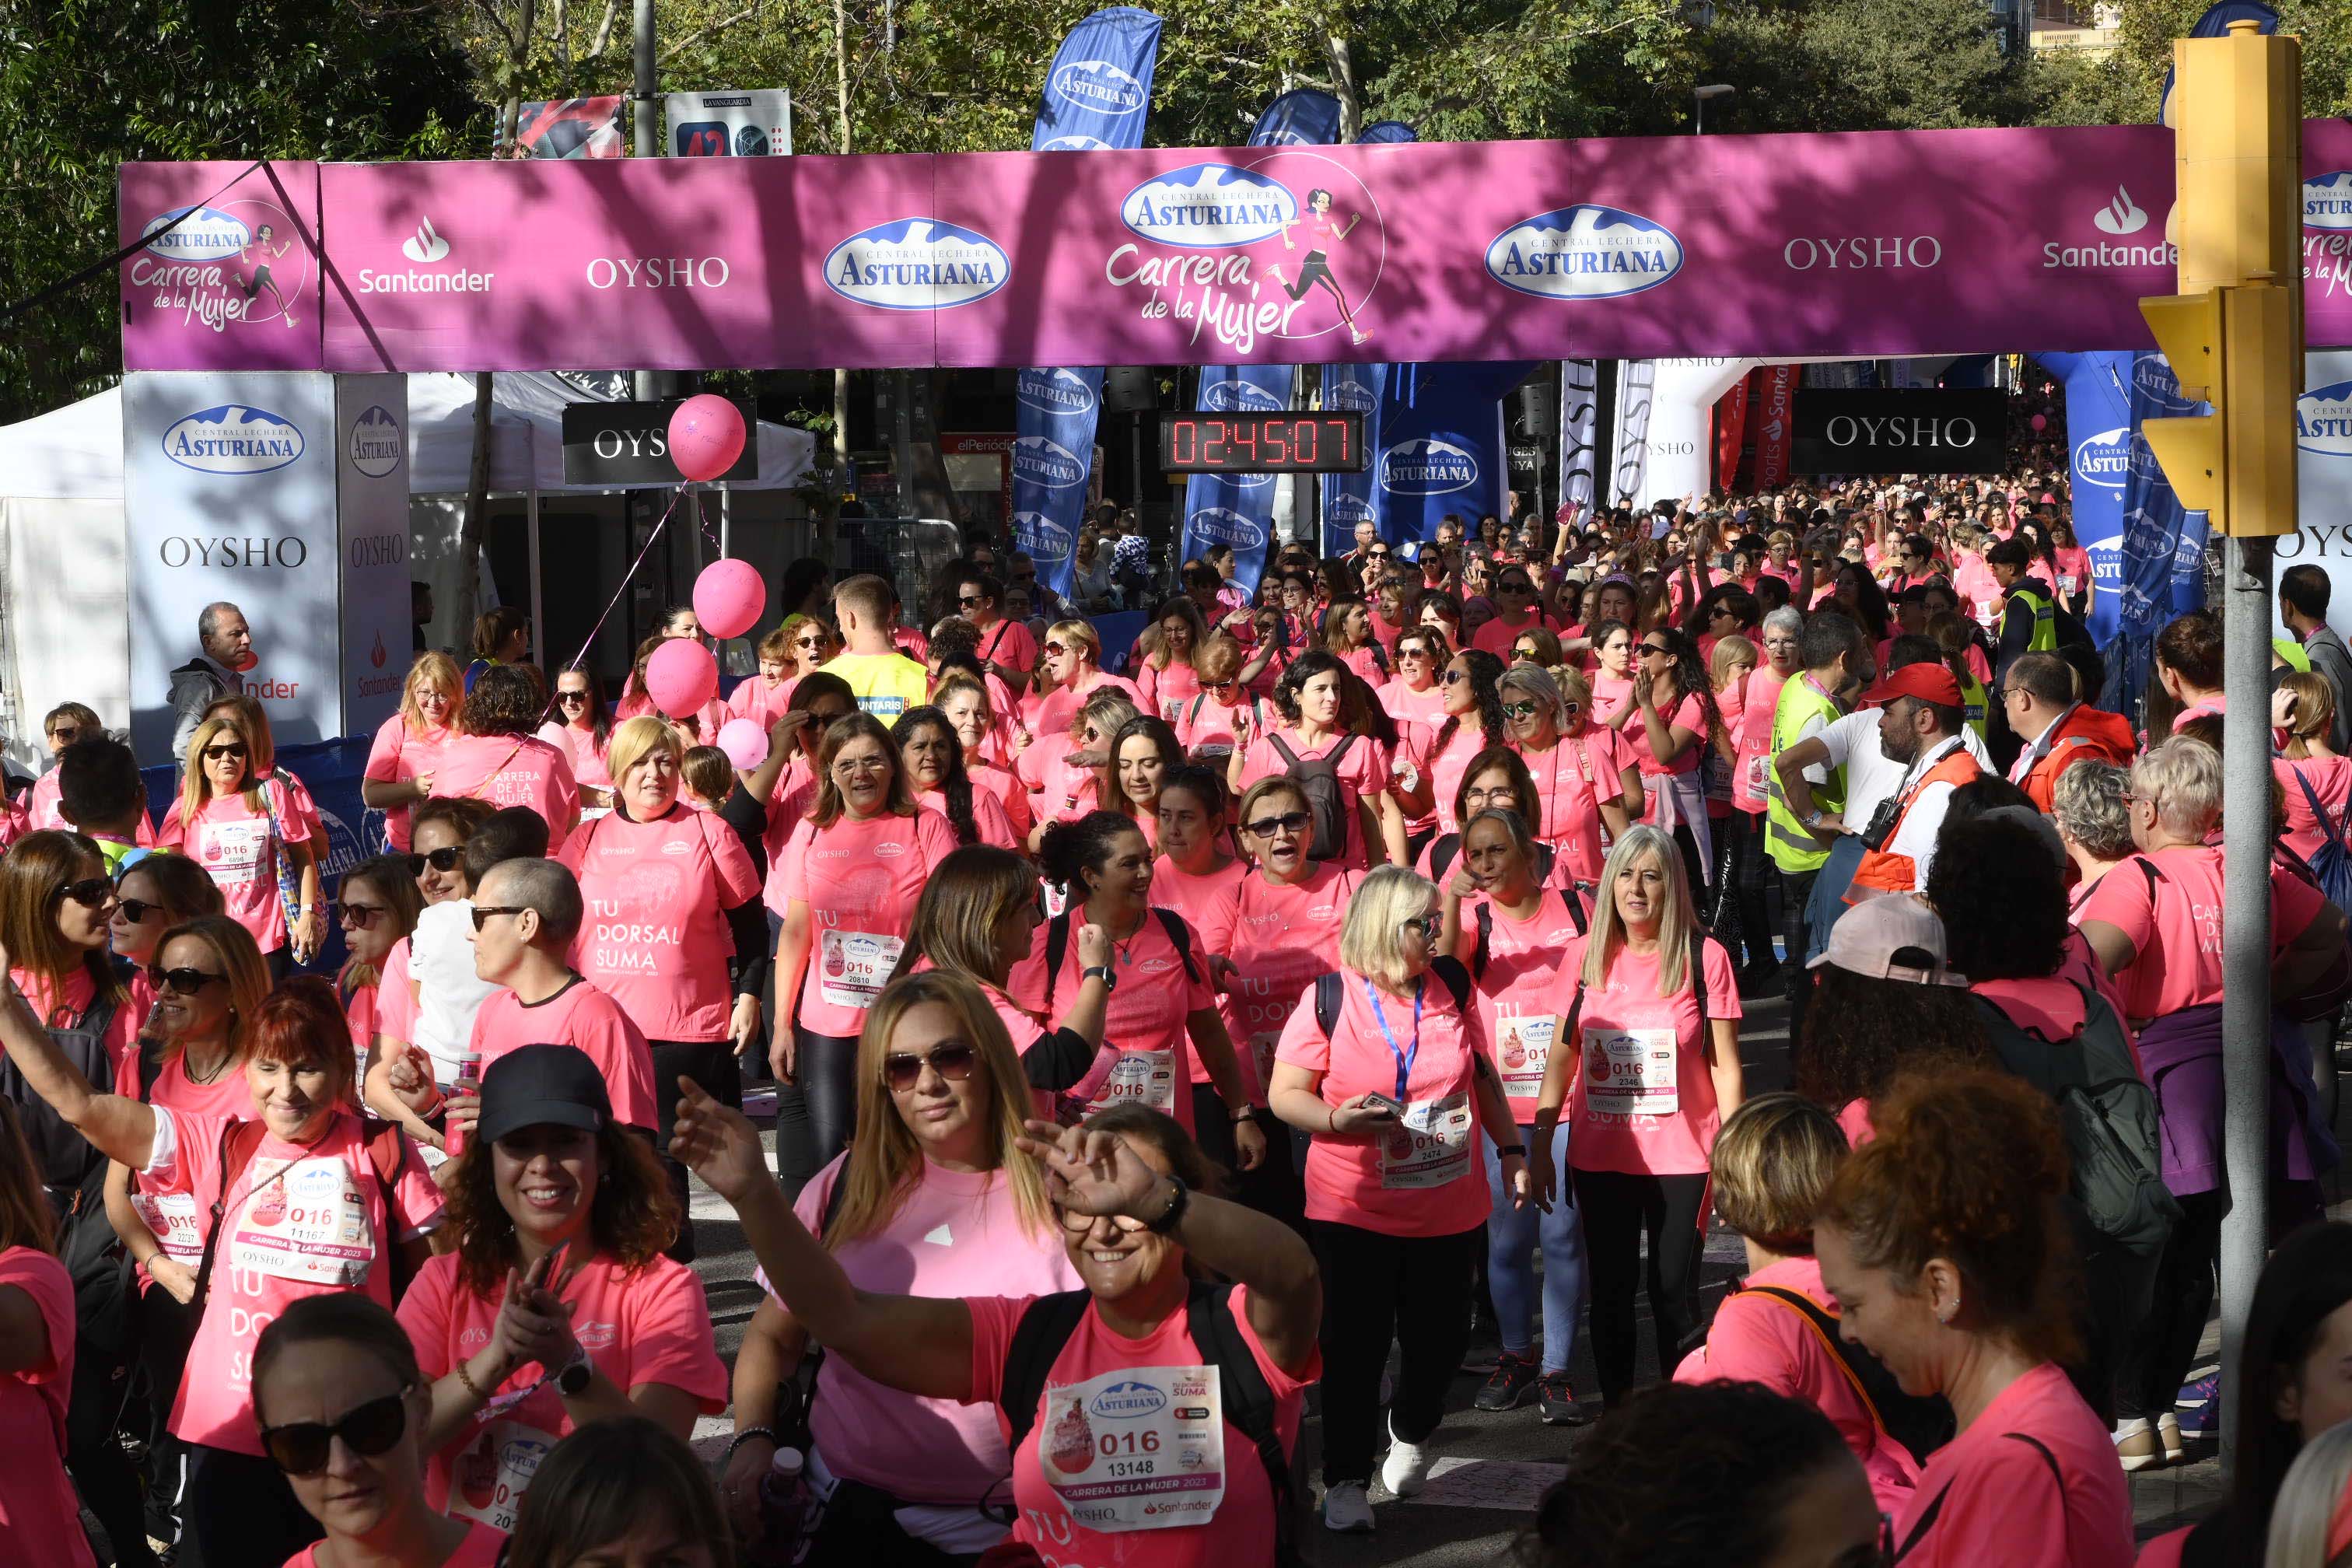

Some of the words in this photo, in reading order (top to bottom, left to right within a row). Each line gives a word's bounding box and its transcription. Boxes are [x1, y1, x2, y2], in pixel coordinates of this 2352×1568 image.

[1059, 72, 1136, 107] ASTURIANA
[1162, 191, 1216, 201] CENTRAL
[1223, 191, 1279, 200] LECHERA
[1134, 195, 1283, 226] ASTURIANA
[2303, 200, 2352, 215] STUR
[1530, 237, 1590, 248] CENTRAL
[1598, 236, 1662, 246] LECHERA
[866, 249, 926, 259] CENTRAL
[1500, 242, 1668, 275] ASTURIANA
[1784, 236, 1942, 270] OYSHO
[2043, 241, 2178, 268] Santande
[131, 258, 222, 286] Carrera
[586, 257, 730, 289] OYSHO
[838, 253, 996, 285] ASTURIANA
[1105, 243, 1251, 286] Carrera
[2315, 256, 2329, 278] la
[359, 268, 495, 293] Santander
[154, 288, 170, 308] de
[174, 288, 187, 309] la
[184, 285, 257, 333] Mujer
[1142, 289, 1169, 319] de
[1175, 289, 1194, 319] la
[1190, 278, 1306, 354] Mujer
[1017, 374, 1087, 408] ASTURIANA
[1566, 359, 1595, 509] OYSH
[1617, 359, 1655, 499] OYSH
[1826, 416, 1977, 449] OYSHO
[173, 430, 295, 457] ASTURIANA
[354, 432, 399, 460] ASTURIANA
[593, 428, 667, 457] OYS
[1173, 420, 1349, 464] 02:45:07
[1647, 441, 1695, 456] YSHO
[1016, 456, 1077, 481] STURIANA
[2081, 450, 2129, 473] ASTU
[1382, 464, 1472, 483] ASTURIANA
[1195, 518, 1256, 545] ASTURIANA
[159, 536, 307, 568] OYSHO
[351, 534, 404, 568] OYSHO
[1017, 532, 1069, 555] TURIANA
[2175, 552, 2200, 566] RIANA
[247, 678, 299, 699] nder
[857, 700, 901, 712] UNTARIS
[497, 783, 515, 793] DE
[516, 782, 531, 793] LA
[495, 793, 534, 804] MUJER
[224, 845, 247, 855] 016
[817, 849, 850, 859] OYSHO
[1550, 838, 1580, 854] SAL
[591, 900, 619, 917] TU
[814, 909, 838, 927] TU
[1244, 910, 1279, 926] OYSHO
[597, 924, 681, 945] DORSAL
[597, 948, 656, 969] SUMA
[846, 961, 873, 974] 016
[849, 975, 870, 984] 20810
[1241, 977, 1270, 996] TU
[1493, 1001, 1520, 1020] TU
[1528, 1048, 1547, 1060] 01
[1610, 1044, 1643, 1052] ASTURIANA
[1612, 1062, 1644, 1075] 016
[1114, 1083, 1144, 1096] 016
[1619, 1078, 1639, 1087] 2346
[1416, 1132, 1445, 1149] 016
[1422, 1149, 1441, 1160] 2474
[290, 1208, 331, 1225] 016
[249, 1235, 288, 1248] CARRERA
[312, 1245, 341, 1255] MUJER
[243, 1251, 284, 1266] OYSHO
[460, 1325, 491, 1346] OYS
[1173, 1388, 1206, 1397] SUMA
[1095, 1395, 1161, 1412] ASTURIANA
[1100, 1430, 1160, 1456] 016
[504, 1451, 537, 1469] ASTUR
[1108, 1461, 1154, 1477] 13148
[497, 1482, 523, 1511] 01
[1066, 1486, 1112, 1498] CARRERA
[1115, 1485, 1128, 1493] DE
[1146, 1480, 1179, 1491] MUJER
[1183, 1478, 1206, 1487] 2023
[1157, 1500, 1213, 1514] Santander
[1027, 1508, 1073, 1545] TU
